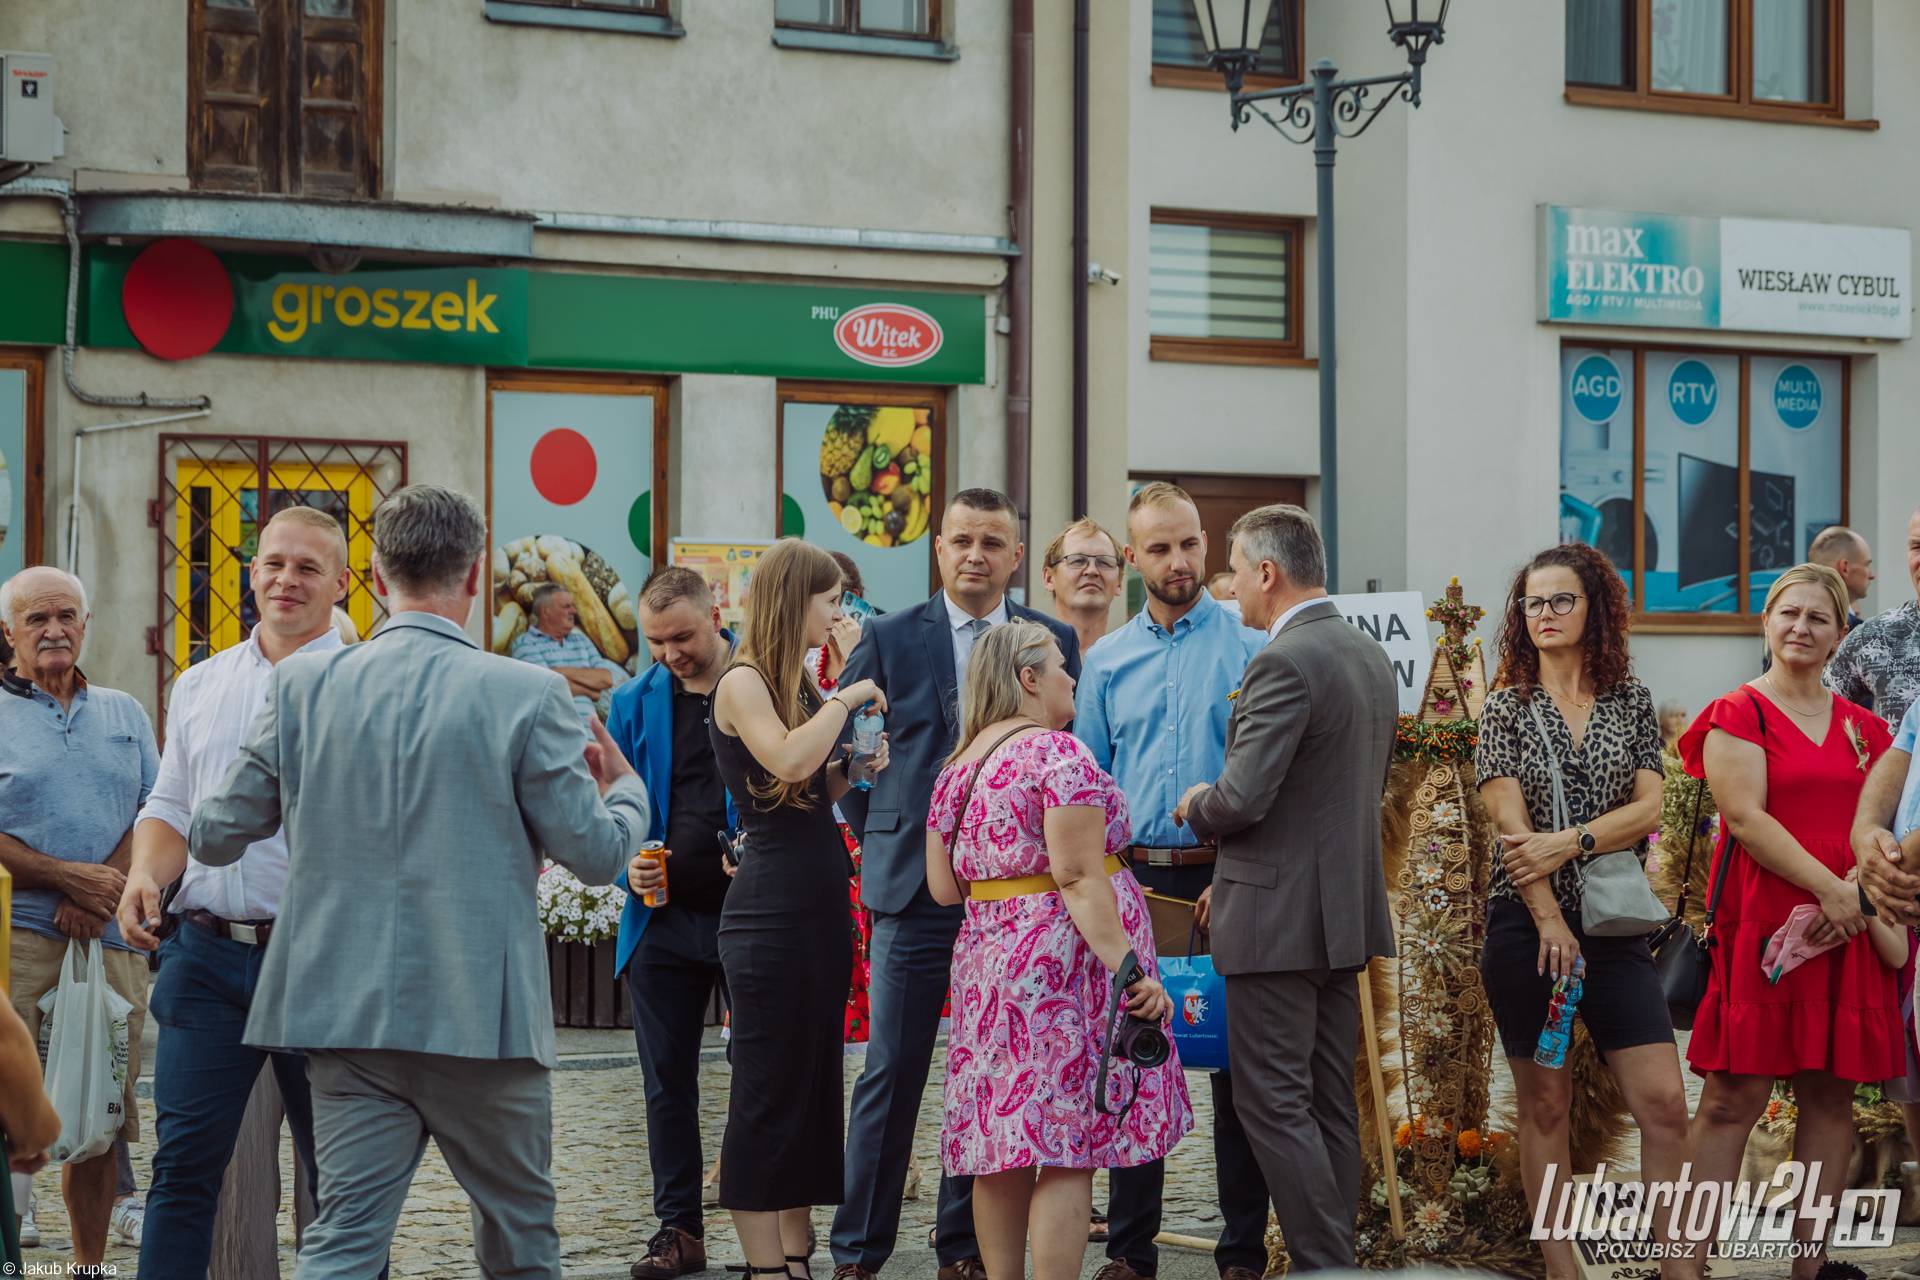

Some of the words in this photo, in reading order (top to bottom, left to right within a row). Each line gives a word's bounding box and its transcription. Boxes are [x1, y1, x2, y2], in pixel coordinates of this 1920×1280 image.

[1566, 224, 1644, 258] max
[1566, 260, 1705, 296] ELEKTRO
[1738, 268, 1832, 294] WIESŁAW
[1837, 274, 1900, 299] CYBUL
[267, 279, 499, 343] groszek
[811, 306, 839, 320] PHU
[851, 317, 922, 348] Witek
[1573, 374, 1621, 398] AGD
[1671, 382, 1716, 406] RTV
[1778, 379, 1817, 395] MULTI
[1776, 397, 1820, 412] MEDIA
